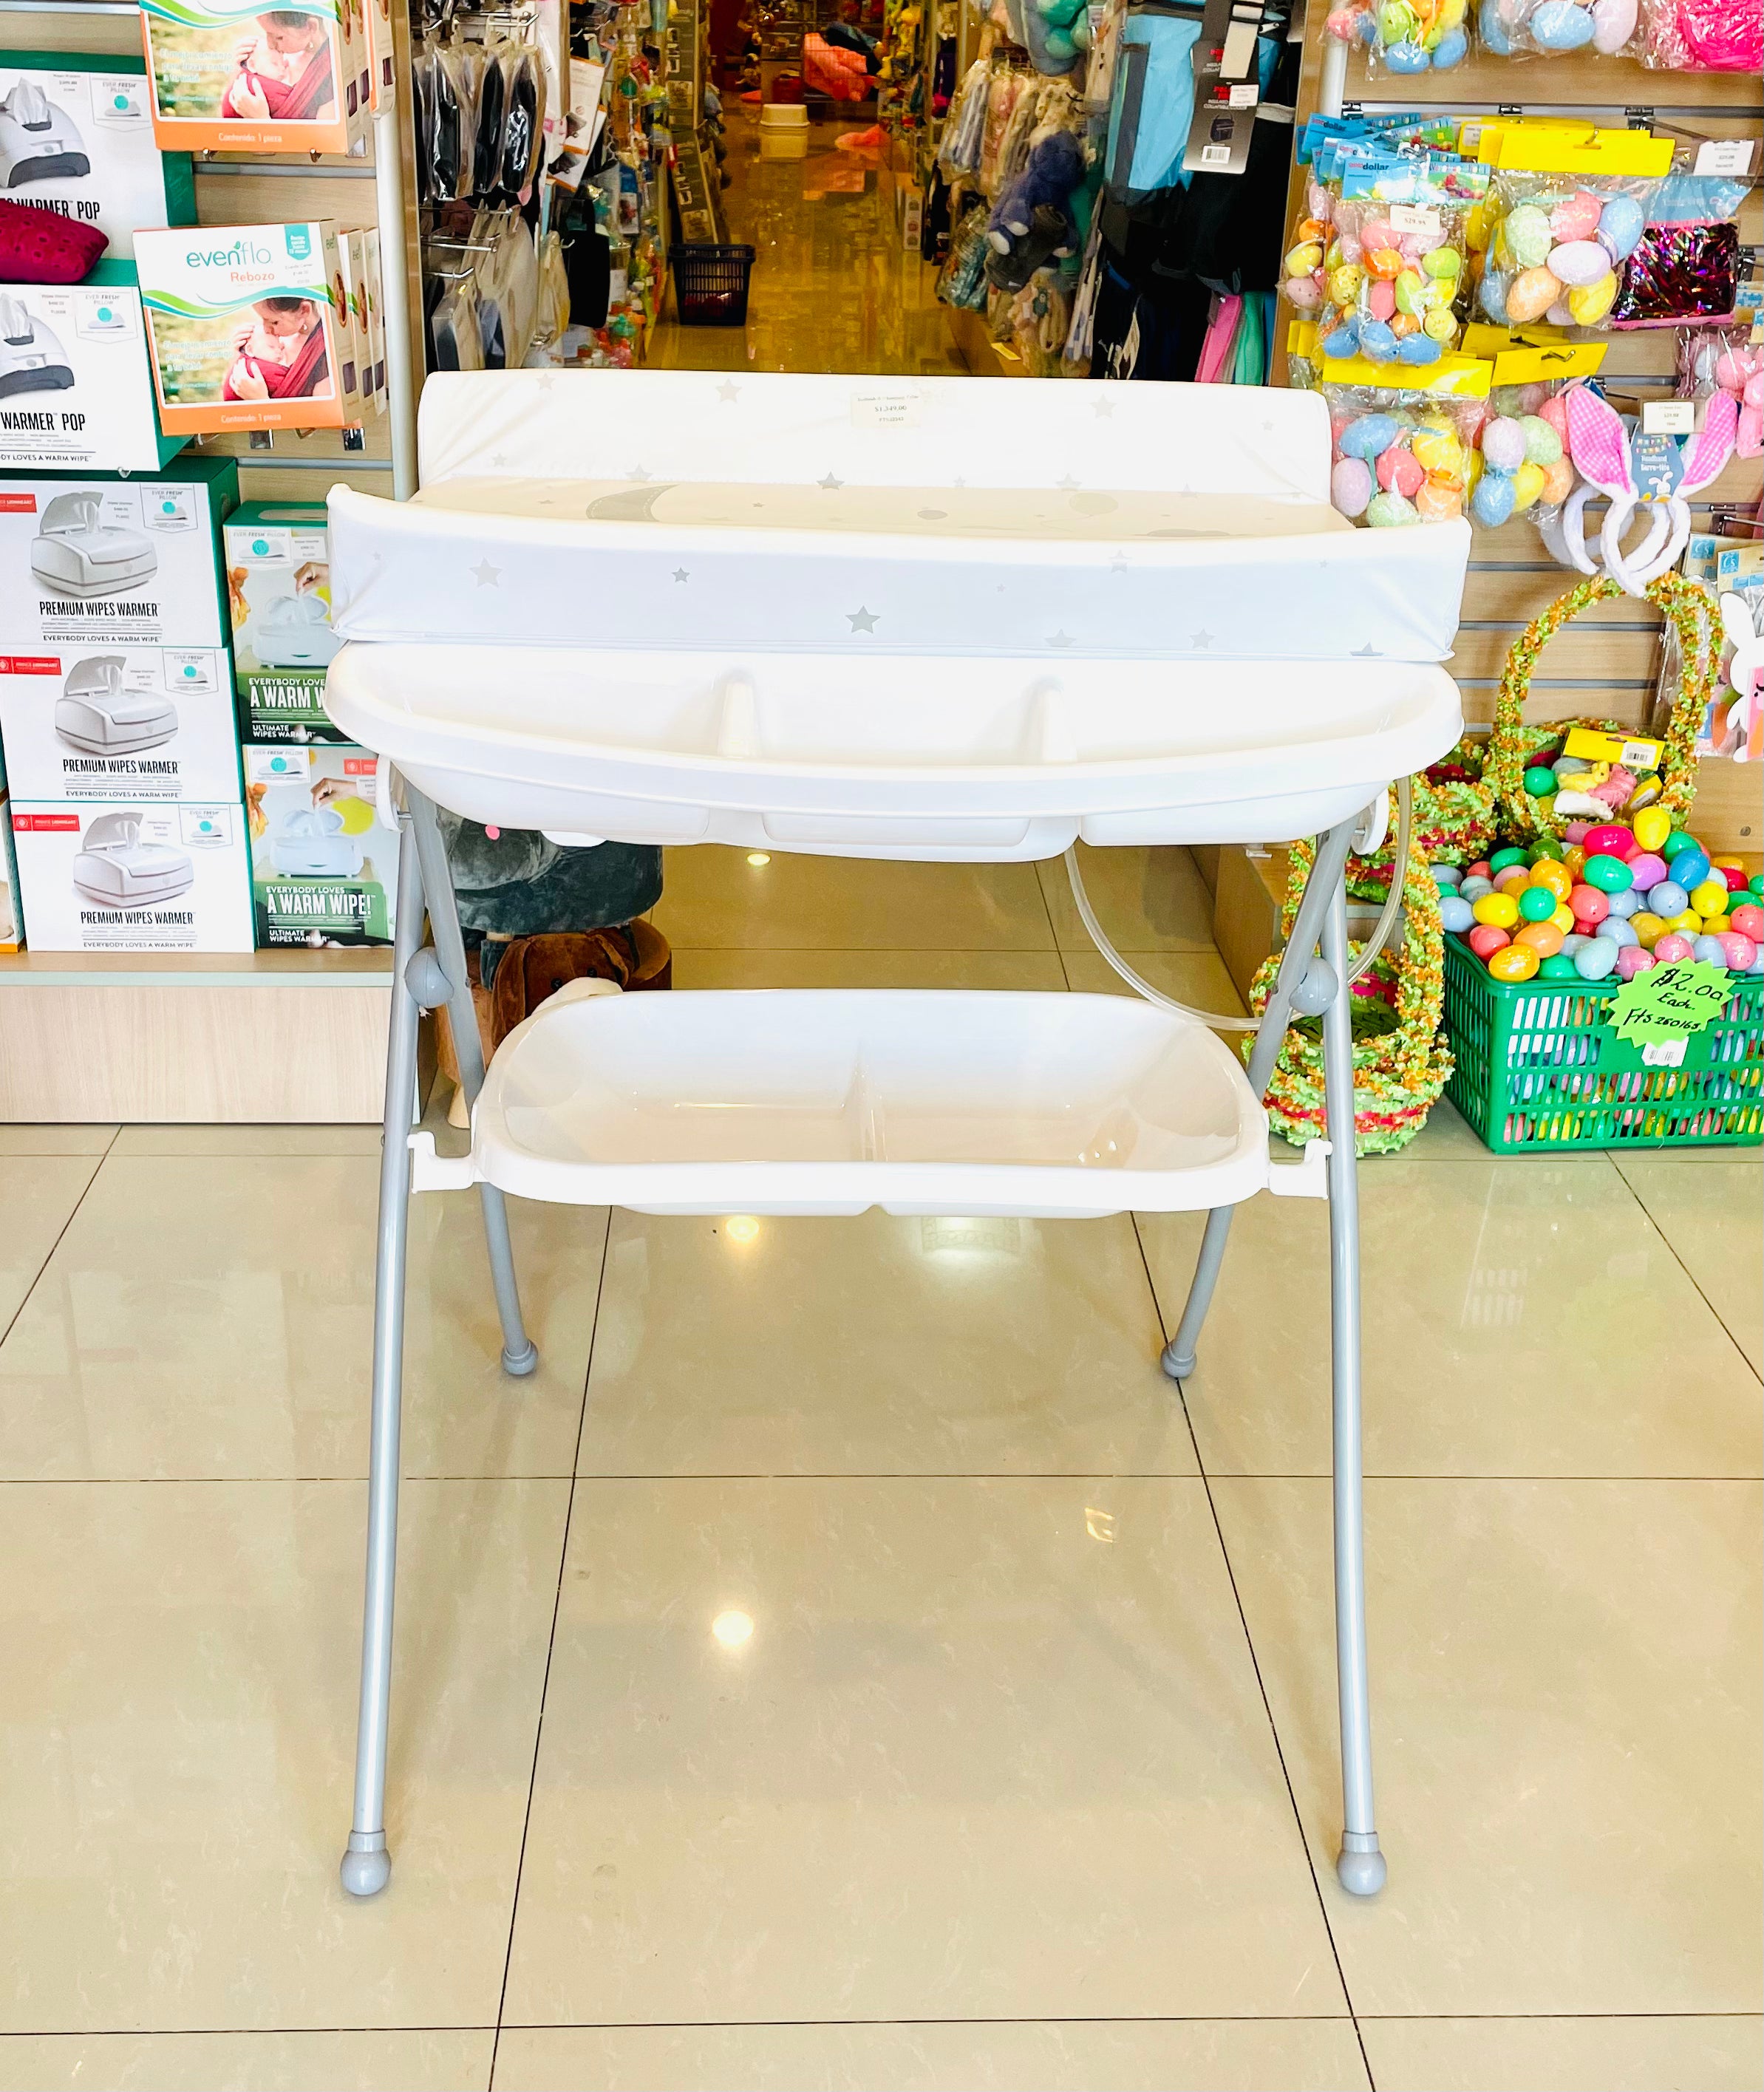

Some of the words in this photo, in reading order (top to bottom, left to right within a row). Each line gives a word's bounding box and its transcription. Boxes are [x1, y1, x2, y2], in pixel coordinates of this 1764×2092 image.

[77, 201, 100, 219] POP
[186, 242, 271, 268] evenflo
[231, 271, 275, 282] Rebozo
[0, 412, 55, 430] WARMER
[61, 413, 86, 431] POP
[39, 601, 84, 616] PREMIUM
[86, 602, 115, 616] WIPES
[117, 602, 158, 617] WARMER
[249, 678, 300, 686] EVERYBODY
[303, 678, 325, 686] LOVE
[251, 686, 260, 707] A
[262, 686, 311, 708] WARM
[63, 759, 106, 772] PREMIUM
[108, 760, 137, 773] WIPES
[138, 760, 178, 774] WARMER
[318, 886, 344, 894] LOVES
[268, 893, 277, 914] A
[279, 893, 326, 915] WARM
[330, 894, 372, 916] WIPE!
[81, 911, 123, 924] PREMIUM
[125, 911, 153, 924] WIPES
[154, 911, 194, 924] WARMER
[1650, 967, 1723, 1001] $2.00
